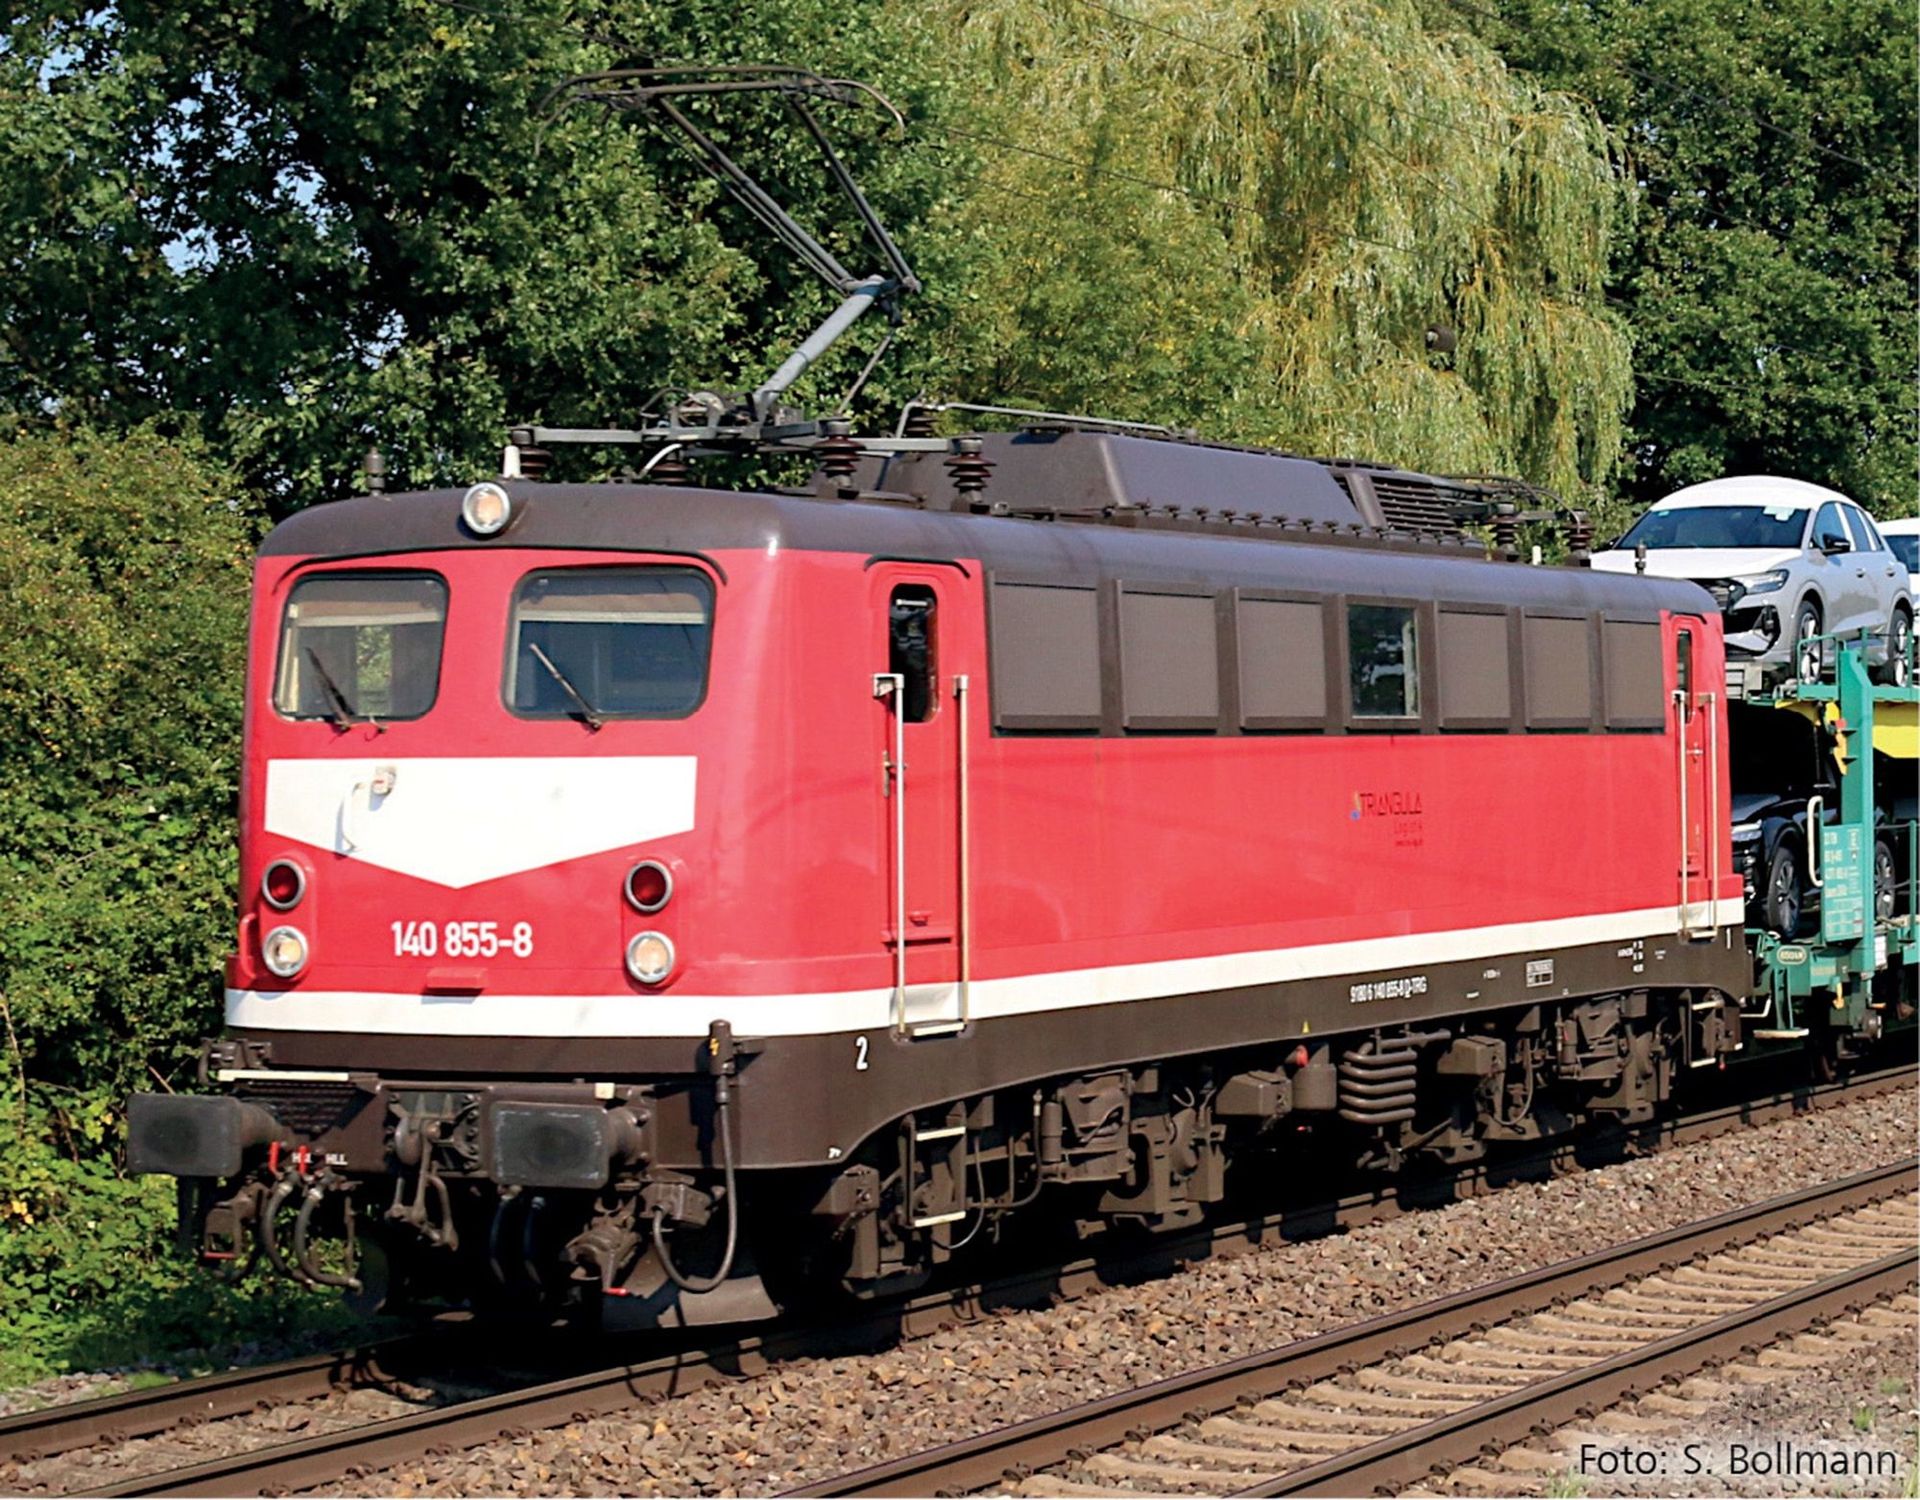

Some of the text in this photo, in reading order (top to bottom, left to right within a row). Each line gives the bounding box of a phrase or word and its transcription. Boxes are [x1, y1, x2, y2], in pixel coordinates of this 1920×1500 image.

[391, 921, 534, 958] 140 855-8
[856, 1036, 869, 1070] 2
[325, 1153, 349, 1165] HLL
